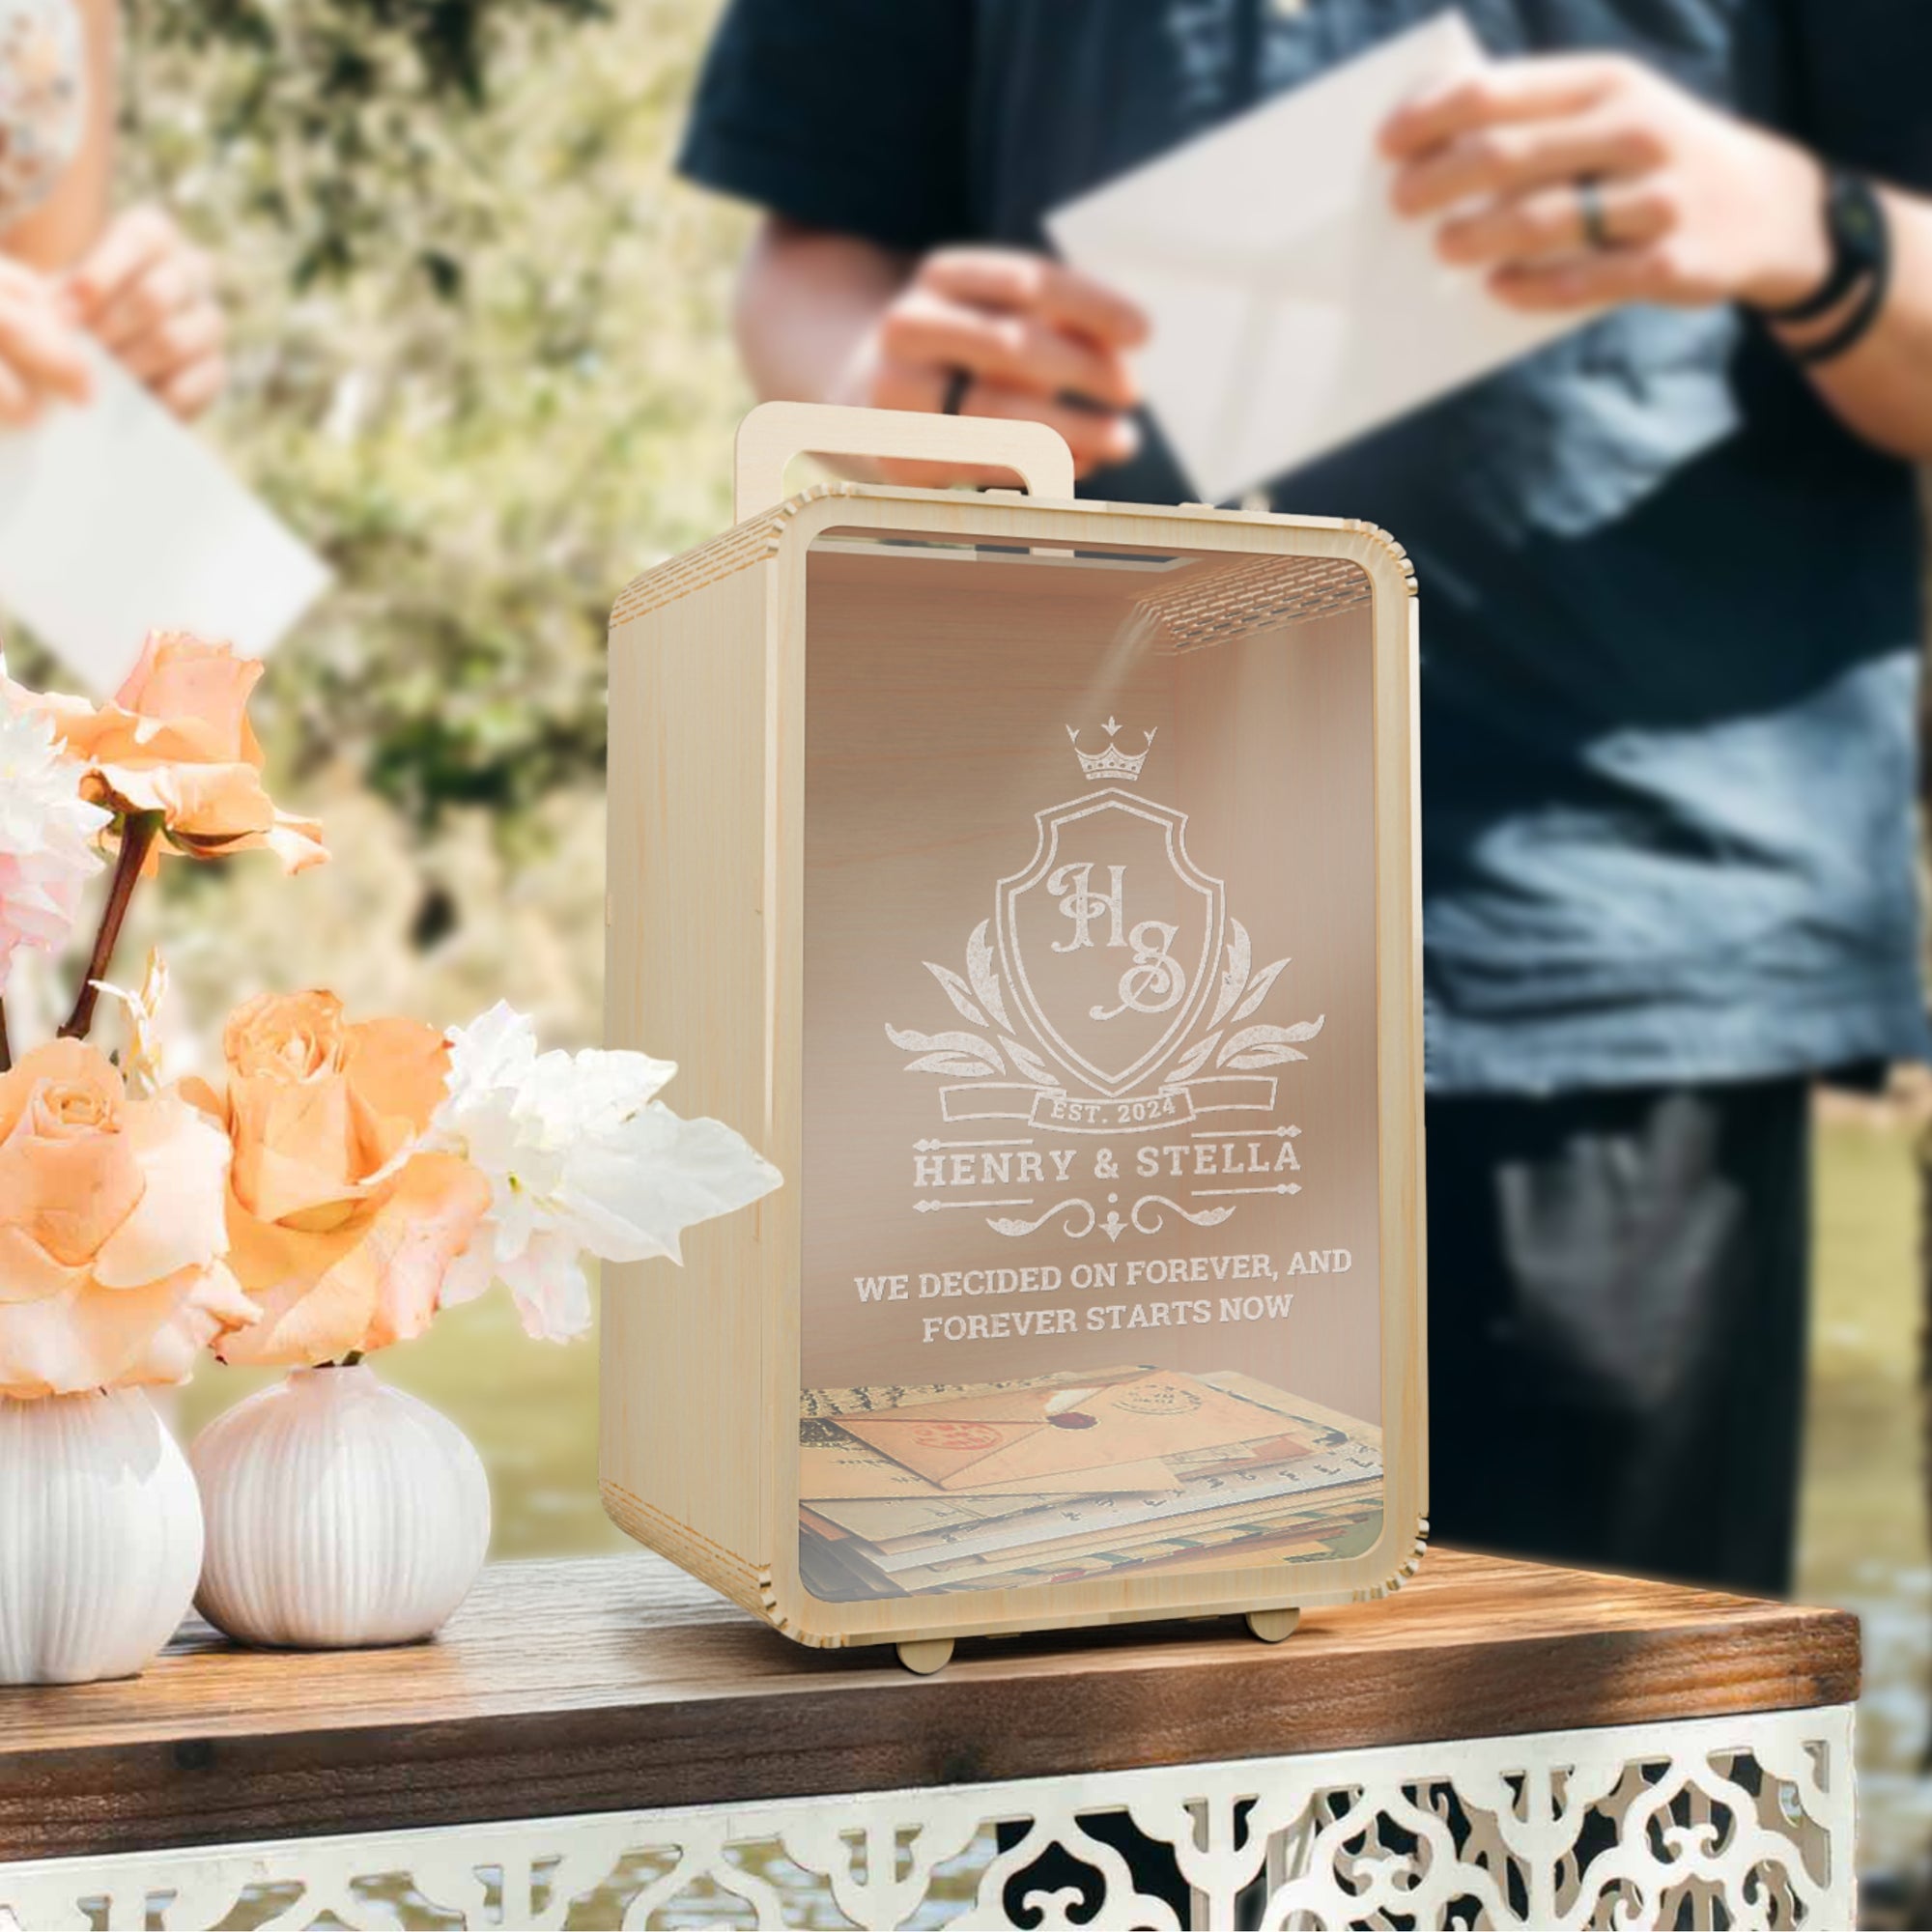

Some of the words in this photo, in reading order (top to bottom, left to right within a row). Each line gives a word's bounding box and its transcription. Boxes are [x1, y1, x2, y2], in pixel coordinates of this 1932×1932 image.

[1050, 1098, 1109, 1123] EST.
[1118, 1096, 1176, 1123] 2024
[914, 1150, 1077, 1187] HENRY
[1094, 1148, 1120, 1179] &
[1136, 1142, 1301, 1178] STELLA
[854, 1274, 909, 1302] WE
[919, 1265, 1062, 1298] DECIDED
[1070, 1263, 1118, 1289] ON
[1126, 1254, 1278, 1286] FOREVER,
[1287, 1248, 1352, 1275] AND
[923, 1308, 1078, 1343] FOREVER
[1086, 1299, 1212, 1330] STARTS
[1219, 1293, 1293, 1322] NOW
